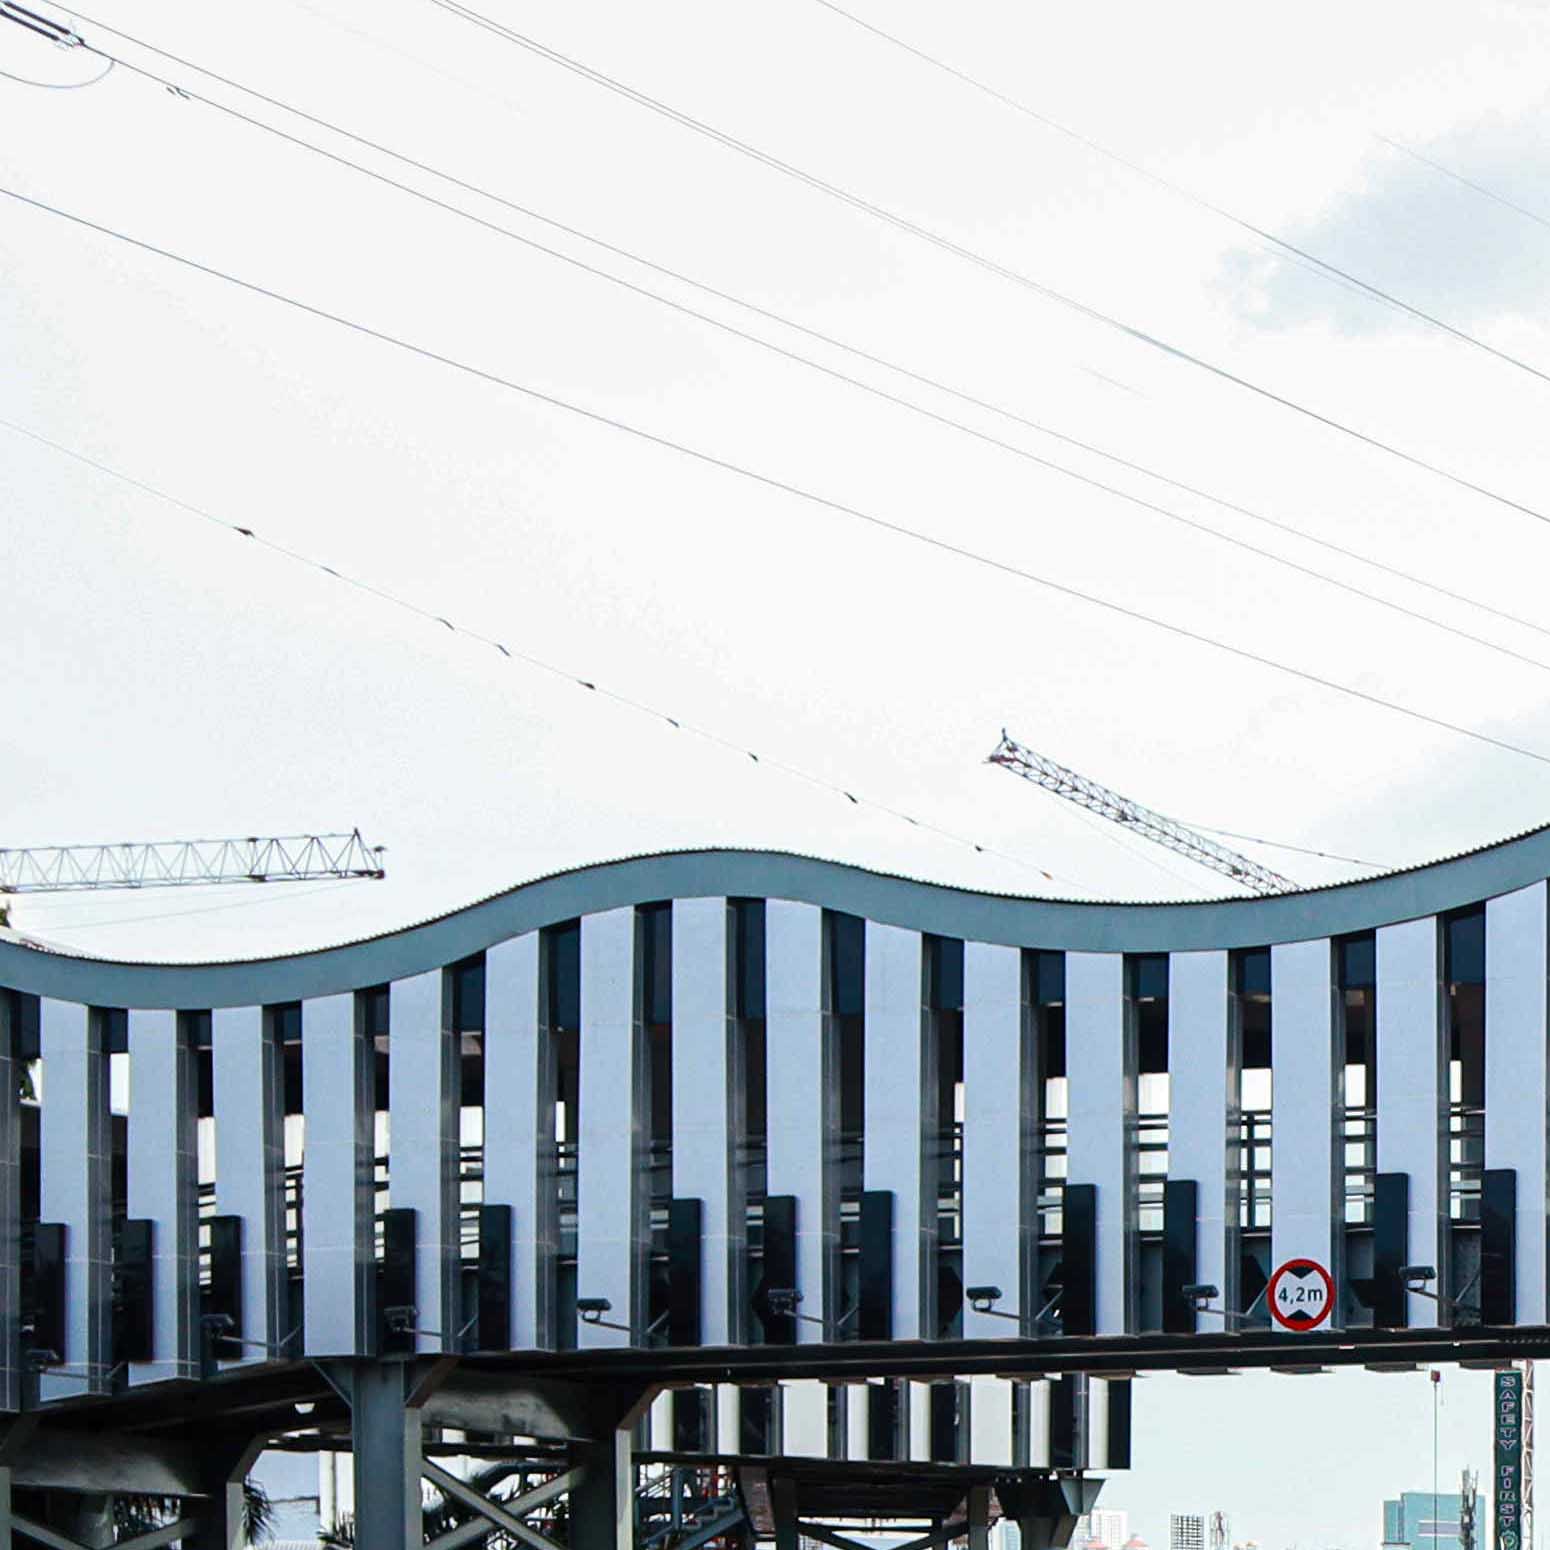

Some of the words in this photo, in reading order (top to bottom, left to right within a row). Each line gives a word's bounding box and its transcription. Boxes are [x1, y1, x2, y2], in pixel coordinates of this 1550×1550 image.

[1278, 1287, 1324, 1304] 4,2m
[1499, 1376, 1517, 1450] SAFETY
[1499, 1464, 1517, 1528] FIRST
